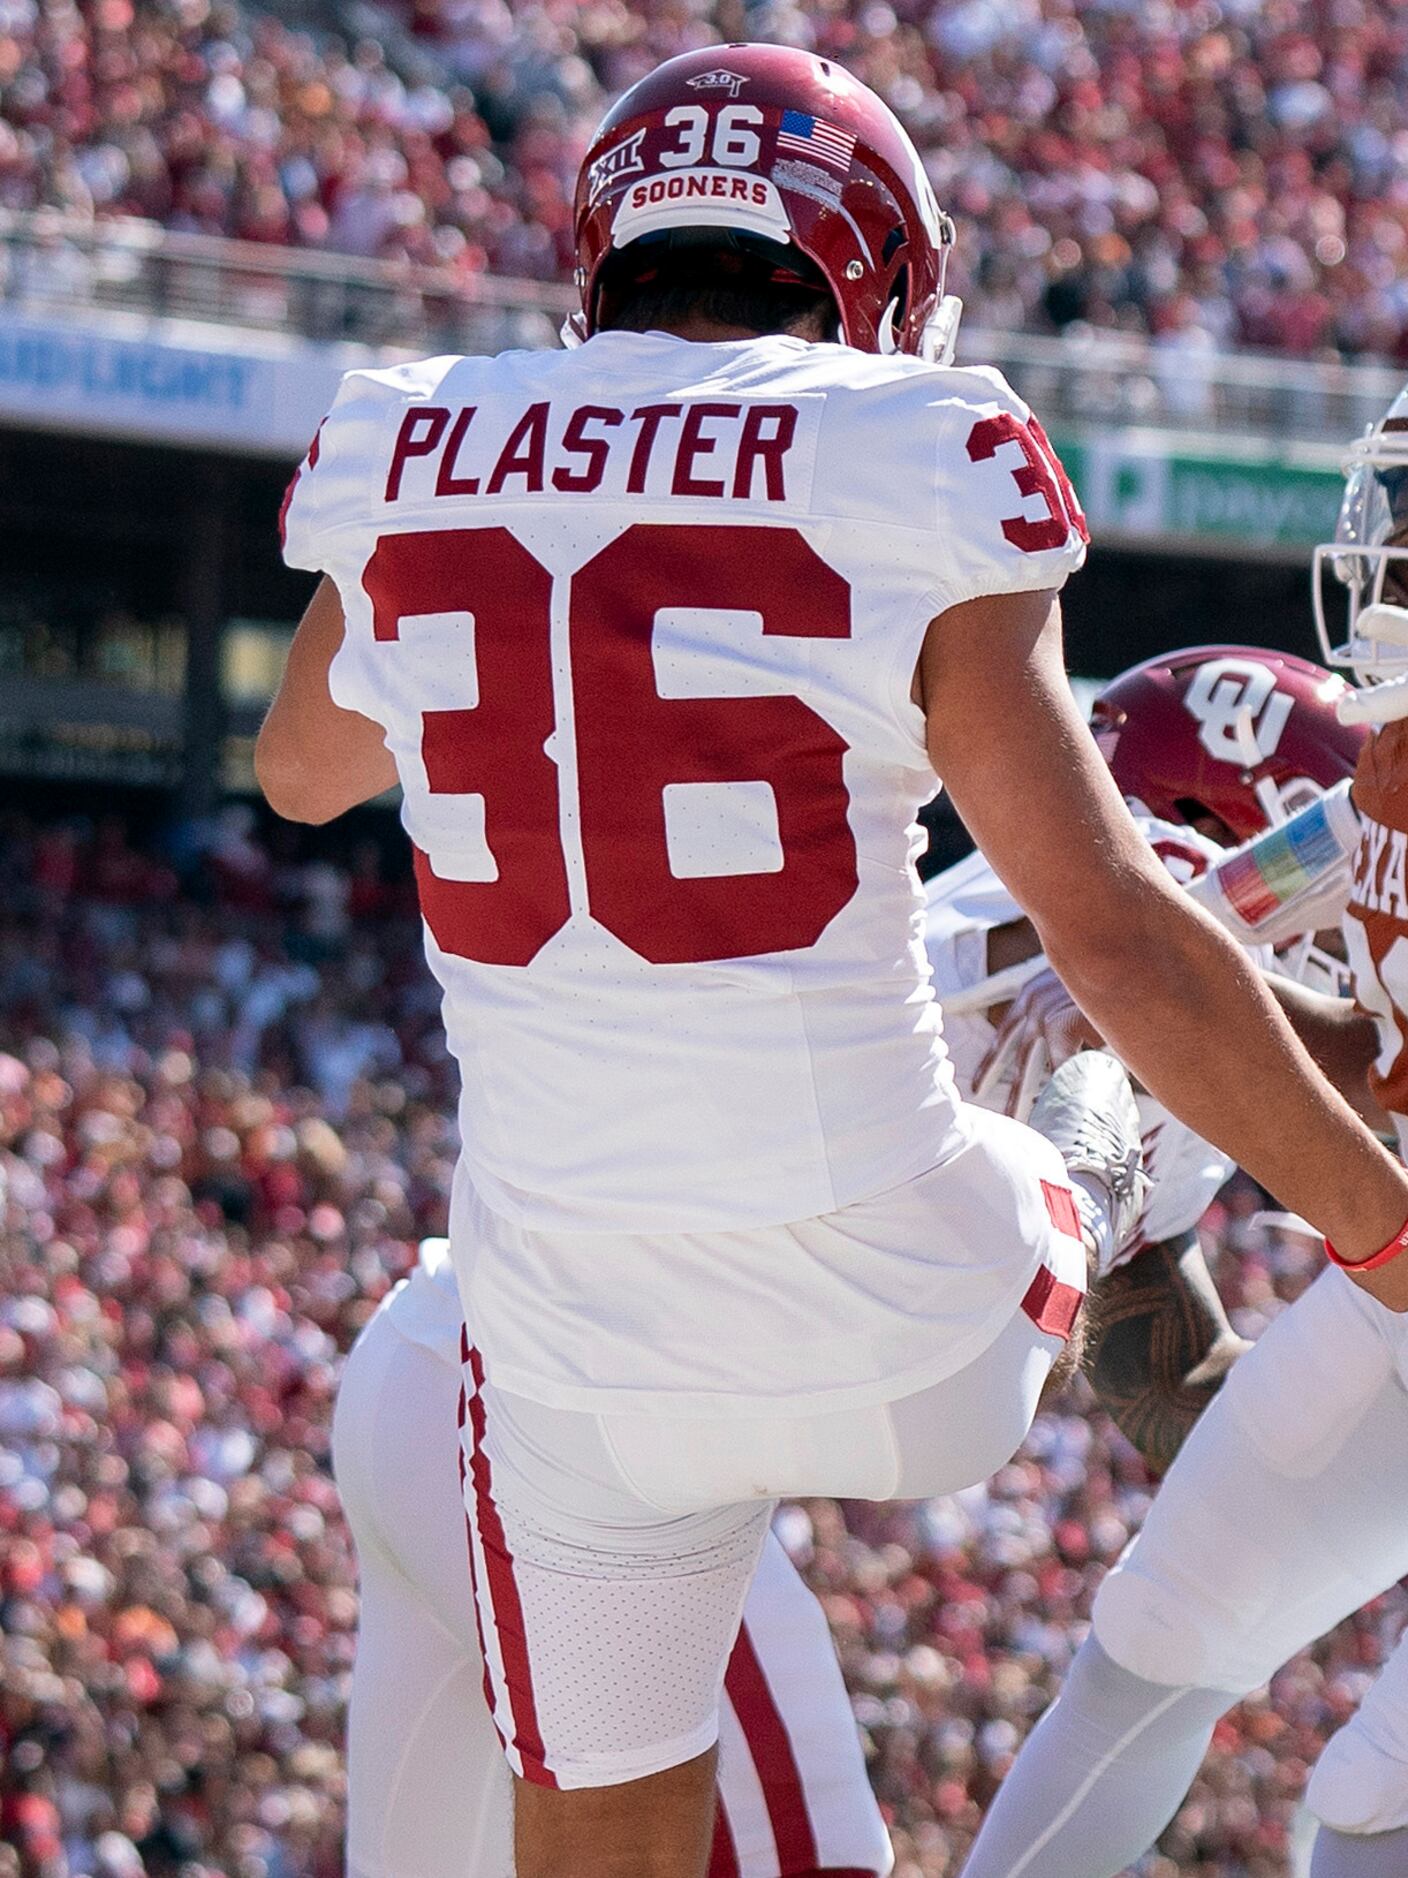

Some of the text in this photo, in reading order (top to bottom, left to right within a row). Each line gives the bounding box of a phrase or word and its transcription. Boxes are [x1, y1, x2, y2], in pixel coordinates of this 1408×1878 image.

[658, 104, 764, 168] 36
[631, 175, 768, 209] SOONERS
[384, 401, 800, 503] PLASTER
[361, 523, 860, 967] 36
[1183, 658, 1296, 767] OU
